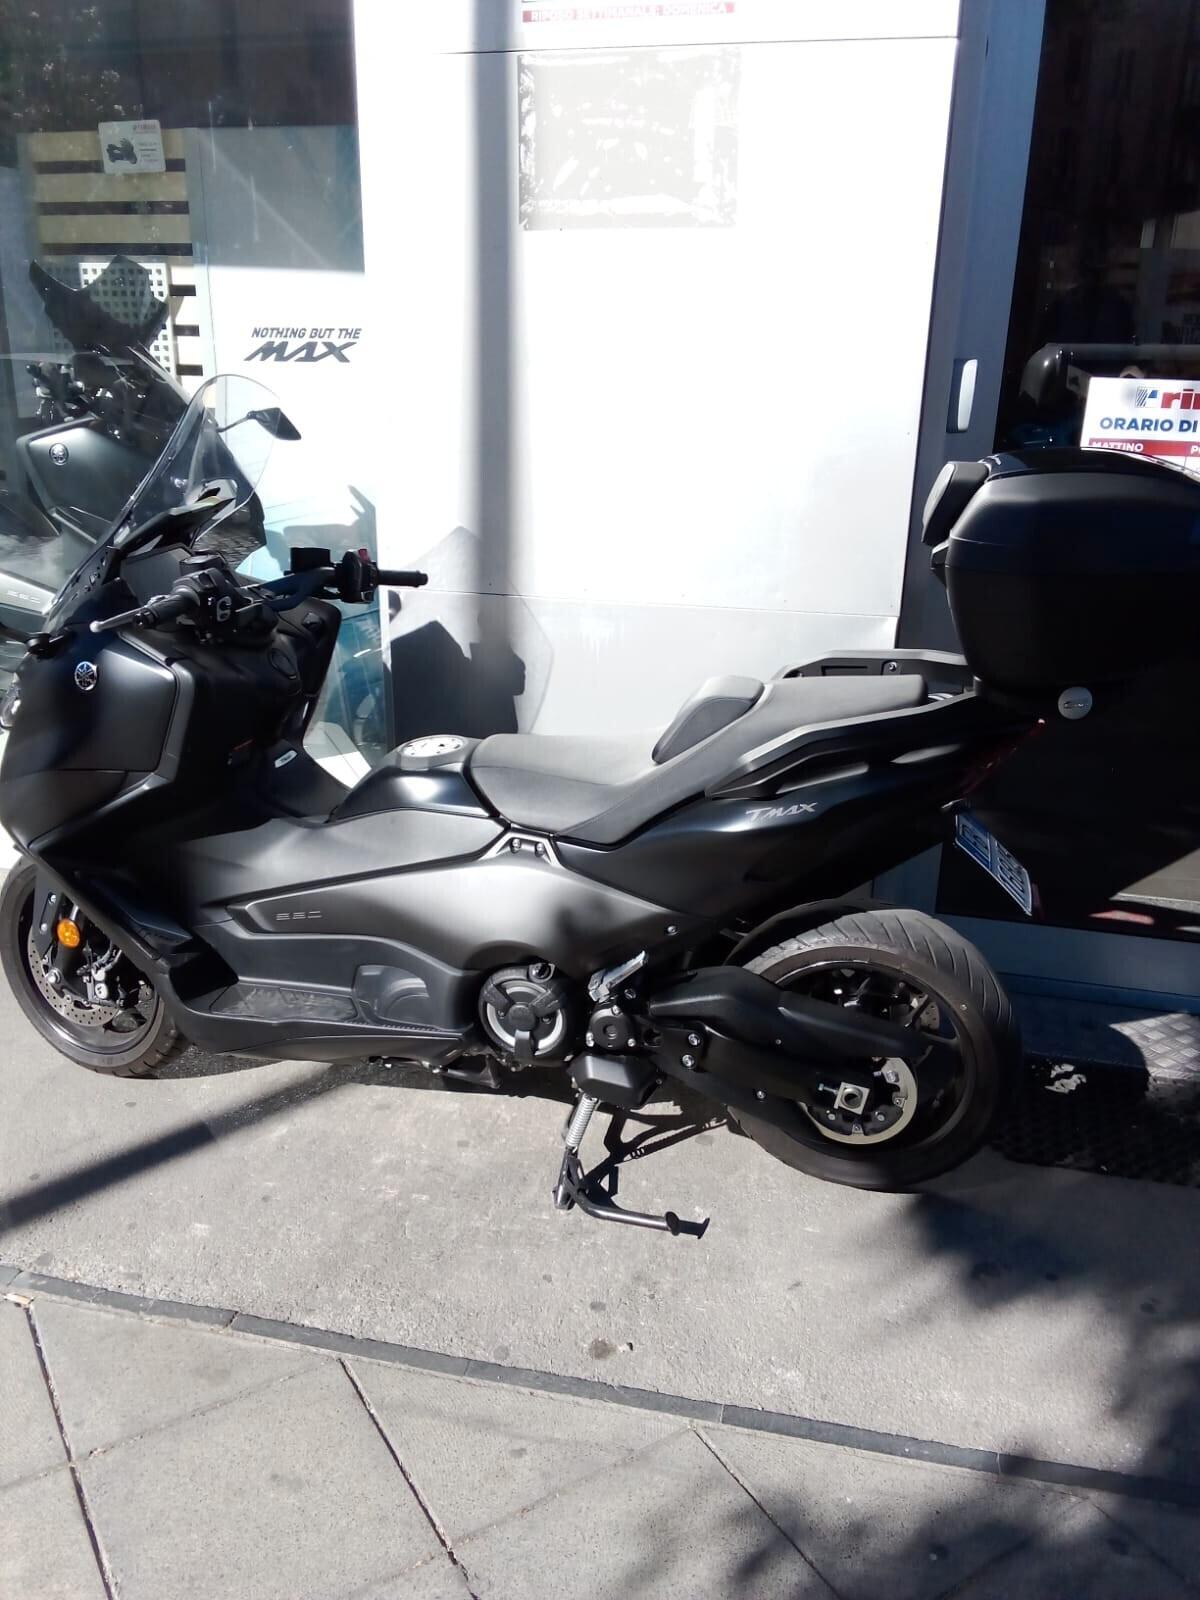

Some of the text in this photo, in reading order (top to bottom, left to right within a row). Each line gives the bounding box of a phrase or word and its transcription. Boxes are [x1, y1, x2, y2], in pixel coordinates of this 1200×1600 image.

[251, 327, 362, 339] NOTHING BUT THE
[243, 340, 357, 363] MAX
[1100, 417, 1198, 432] ORARIO DI
[1091, 441, 1144, 452] MATTINO
[745, 802, 818, 821] TMAX
